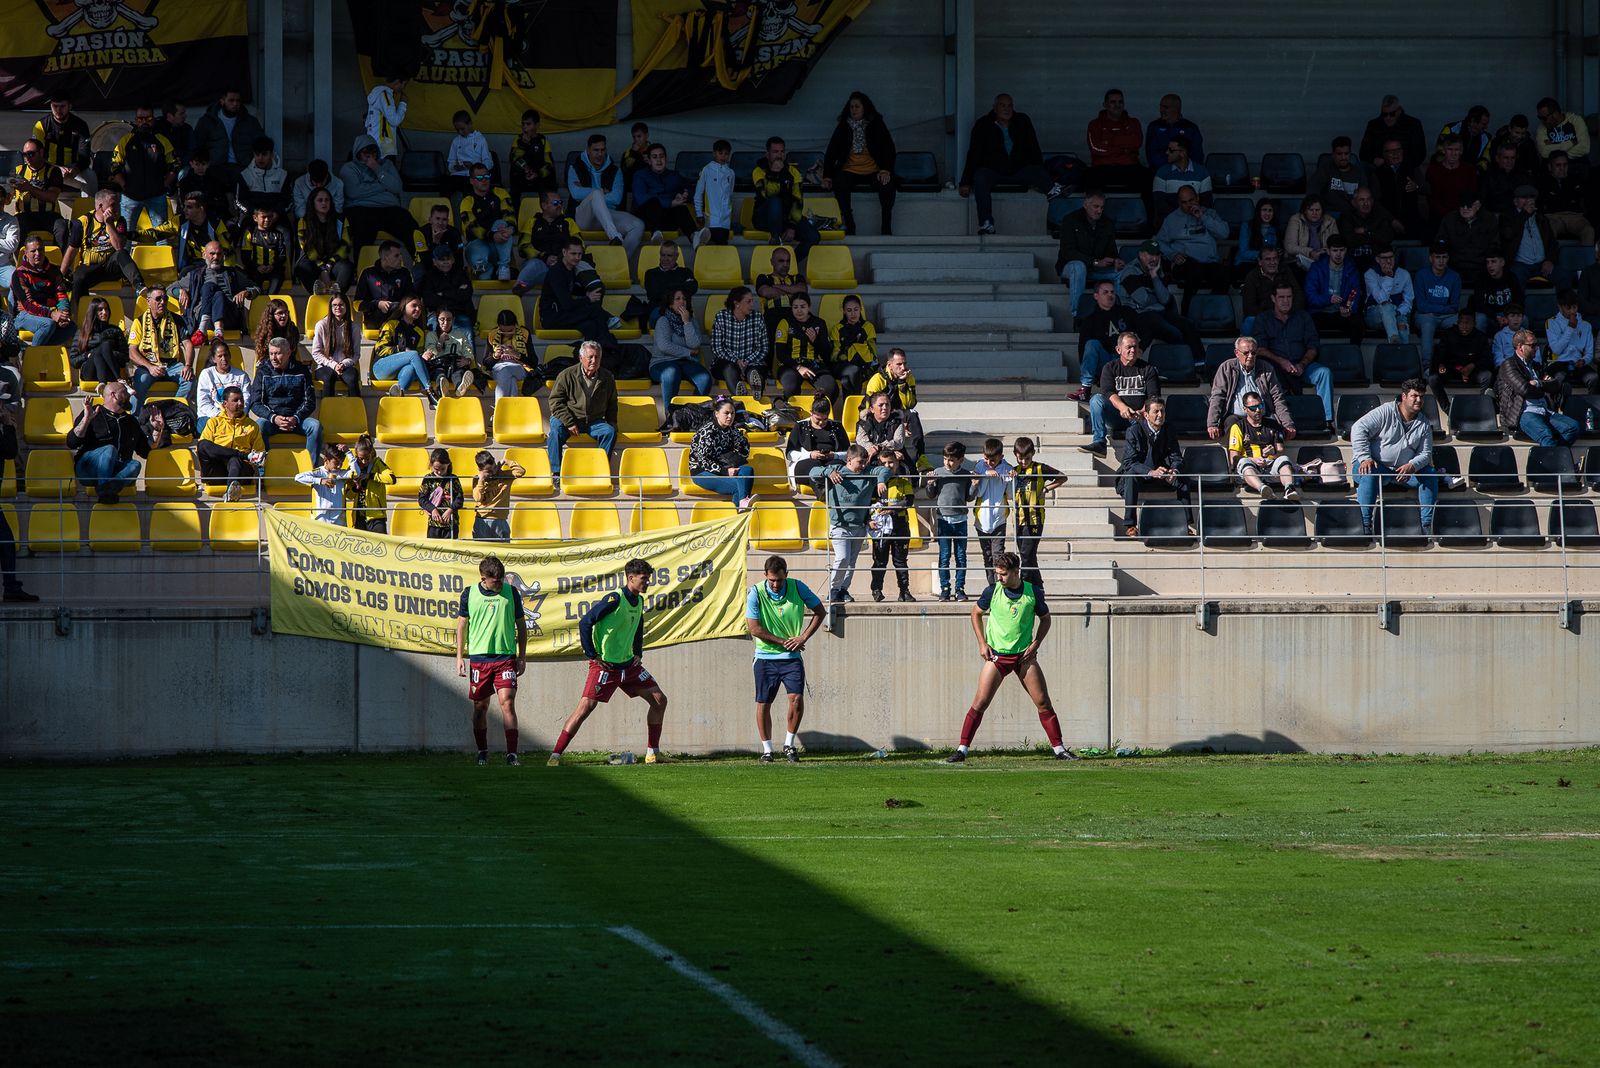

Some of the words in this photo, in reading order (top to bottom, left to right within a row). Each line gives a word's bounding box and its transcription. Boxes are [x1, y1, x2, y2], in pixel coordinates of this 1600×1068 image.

[60, 27, 145, 54] PASIÓN
[44, 47, 168, 73] AURINEGRA
[433, 49, 513, 67] PASI
[417, 65, 534, 87] AURINA
[276, 518, 388, 557] Nuestros
[287, 547, 335, 576] COMO
[341, 561, 433, 592] NOSOTROS
[439, 574, 464, 593] NO
[557, 567, 670, 595] DECIDIOS
[677, 559, 714, 583] SER
[294, 576, 351, 604] SOMOS
[356, 589, 389, 612] LOS
[394, 594, 460, 619] UNICOS
[565, 600, 600, 620] LO
[643, 585, 704, 612] JORES
[331, 612, 385, 638] SAN
[389, 620, 458, 647] ROQU
